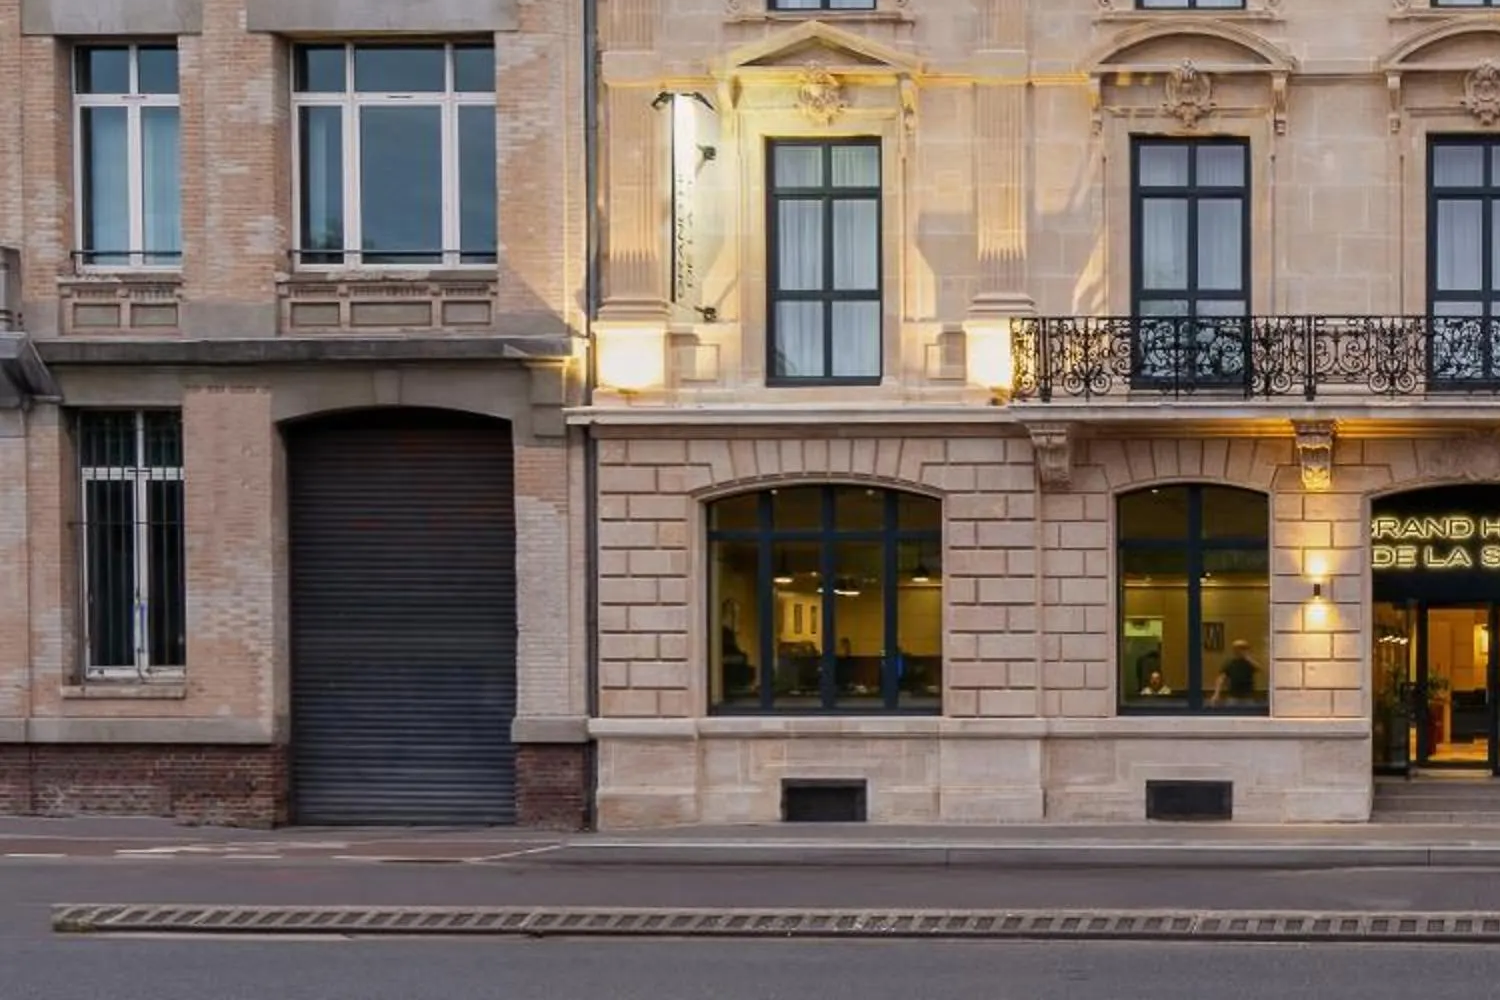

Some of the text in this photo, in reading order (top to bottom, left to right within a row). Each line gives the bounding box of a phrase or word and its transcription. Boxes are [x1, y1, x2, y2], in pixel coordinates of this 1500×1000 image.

[1371, 516, 1475, 539] RAND
[1371, 545, 1417, 568] DE
[1423, 545, 1472, 567] LA
